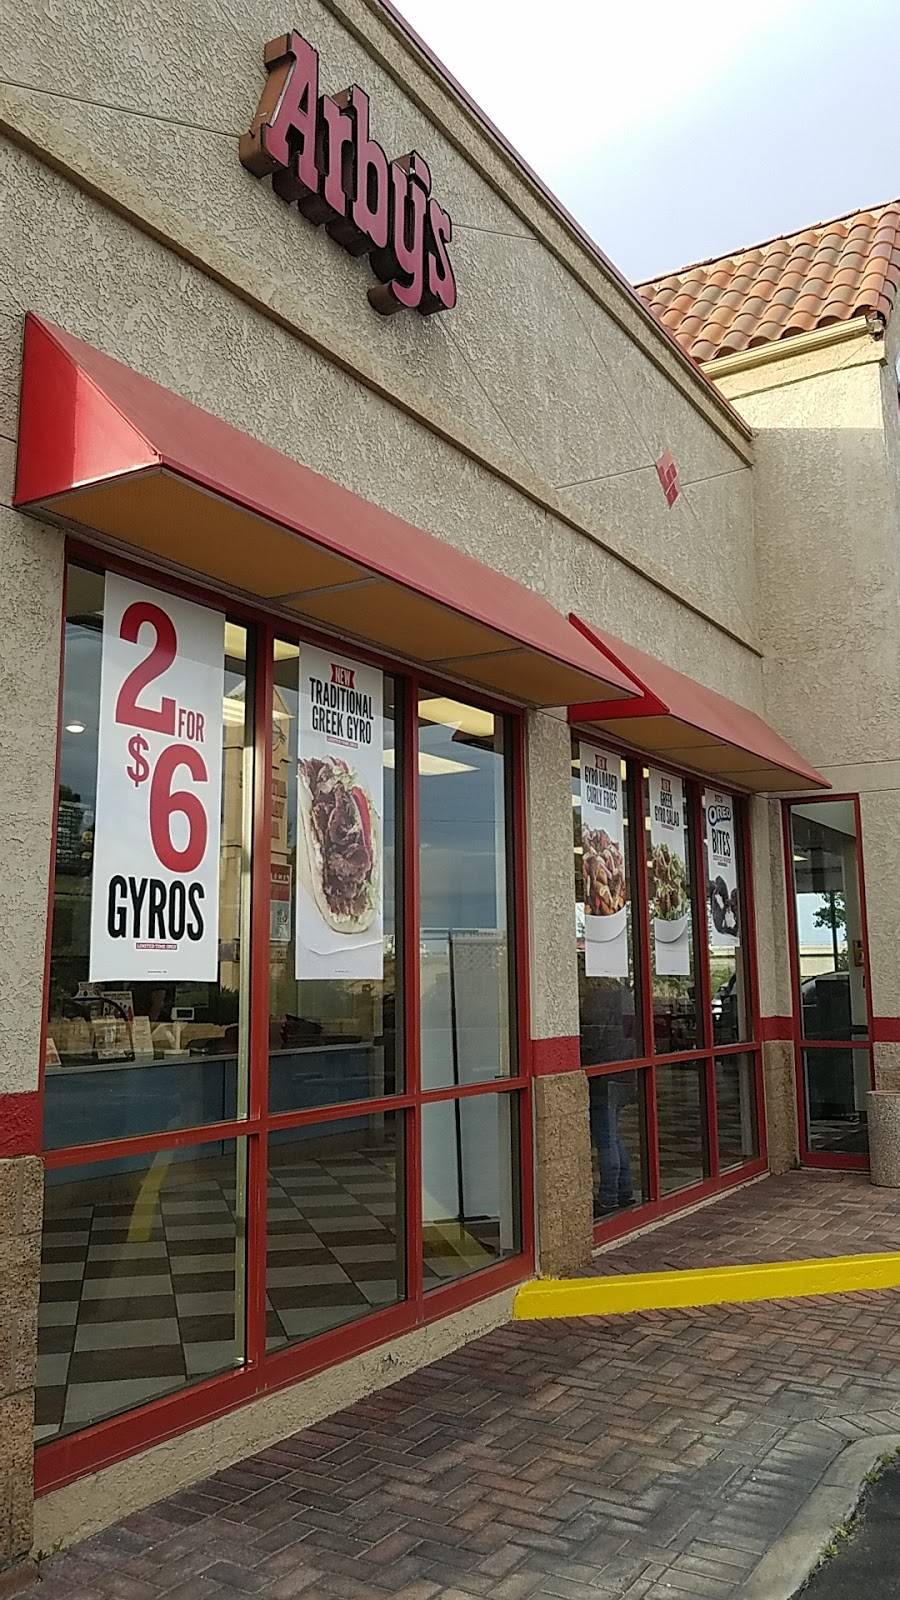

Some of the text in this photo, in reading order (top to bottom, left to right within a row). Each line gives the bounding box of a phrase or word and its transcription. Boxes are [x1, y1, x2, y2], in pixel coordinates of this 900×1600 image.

[262, 28, 457, 309] Arby's
[115, 601, 204, 743] 2 FOR
[309, 677, 374, 720] TRADITIONAL
[334, 666, 351, 687] NEW
[312, 705, 372, 745] GREEK GYRO
[126, 733, 209, 874] $6
[711, 828, 731, 857] BITES
[107, 874, 205, 942] GYROS
